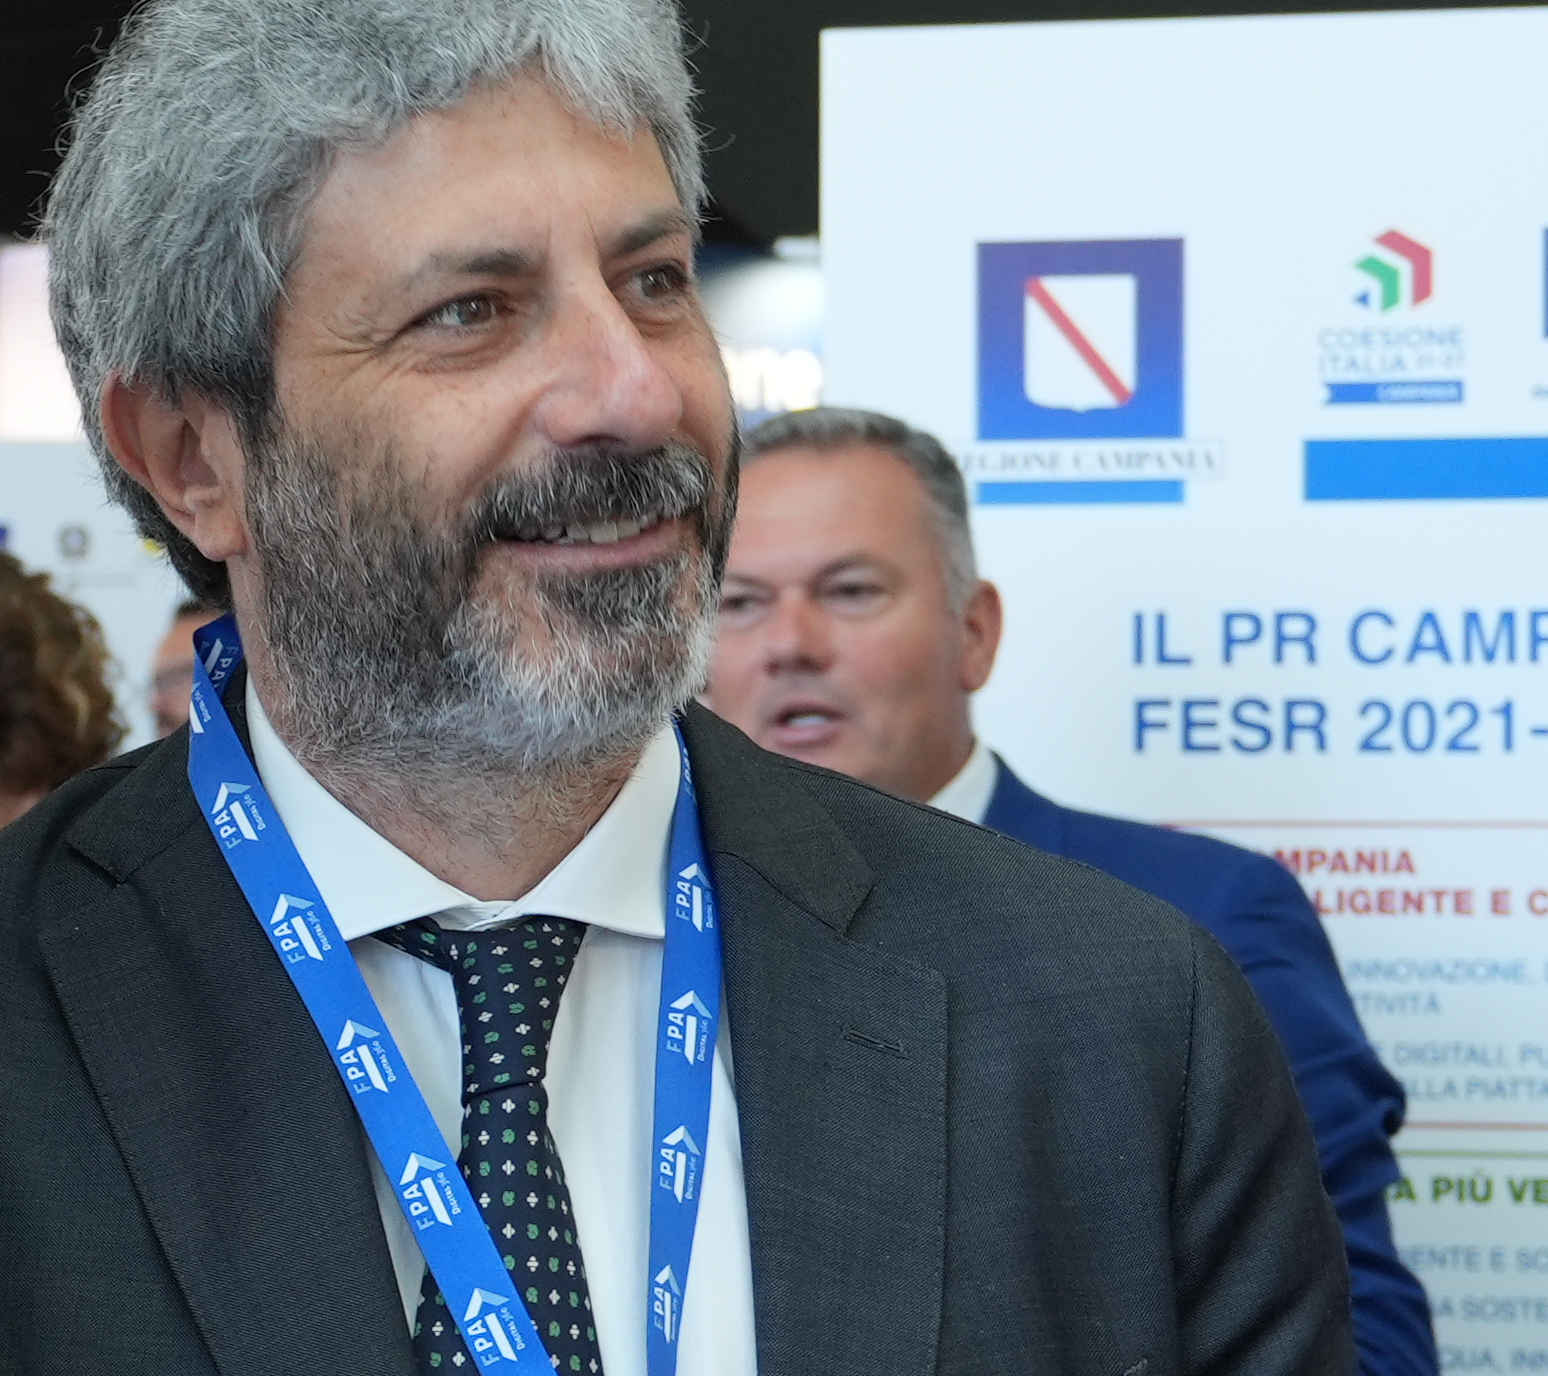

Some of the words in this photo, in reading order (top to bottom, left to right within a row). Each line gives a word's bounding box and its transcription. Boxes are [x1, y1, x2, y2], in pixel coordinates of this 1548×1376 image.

[1319, 325, 1465, 351] COESIONE
[1319, 352, 1405, 374] ITALIA
[961, 450, 1060, 472] EGIONE
[1073, 449, 1215, 471] CAMPANIA
[1132, 611, 1191, 666] IL
[1221, 611, 1318, 666] PR
[1133, 699, 1328, 753] FESR
[214, 809, 242, 850] FPA
[1271, 848, 1417, 874] MPANIA
[675, 880, 691, 921] FPA
[1312, 889, 1474, 916] LIGENTE
[1490, 889, 1512, 916] E
[274, 922, 306, 965] FPA
[665, 1012, 684, 1053] FPA
[340, 1048, 372, 1094] FPA
[659, 1147, 676, 1190] FPA
[1431, 1168, 1495, 1204] PIÙ
[403, 1182, 436, 1231] FPA
[1489, 1245, 1505, 1272] E
[467, 1318, 501, 1367] FPA
